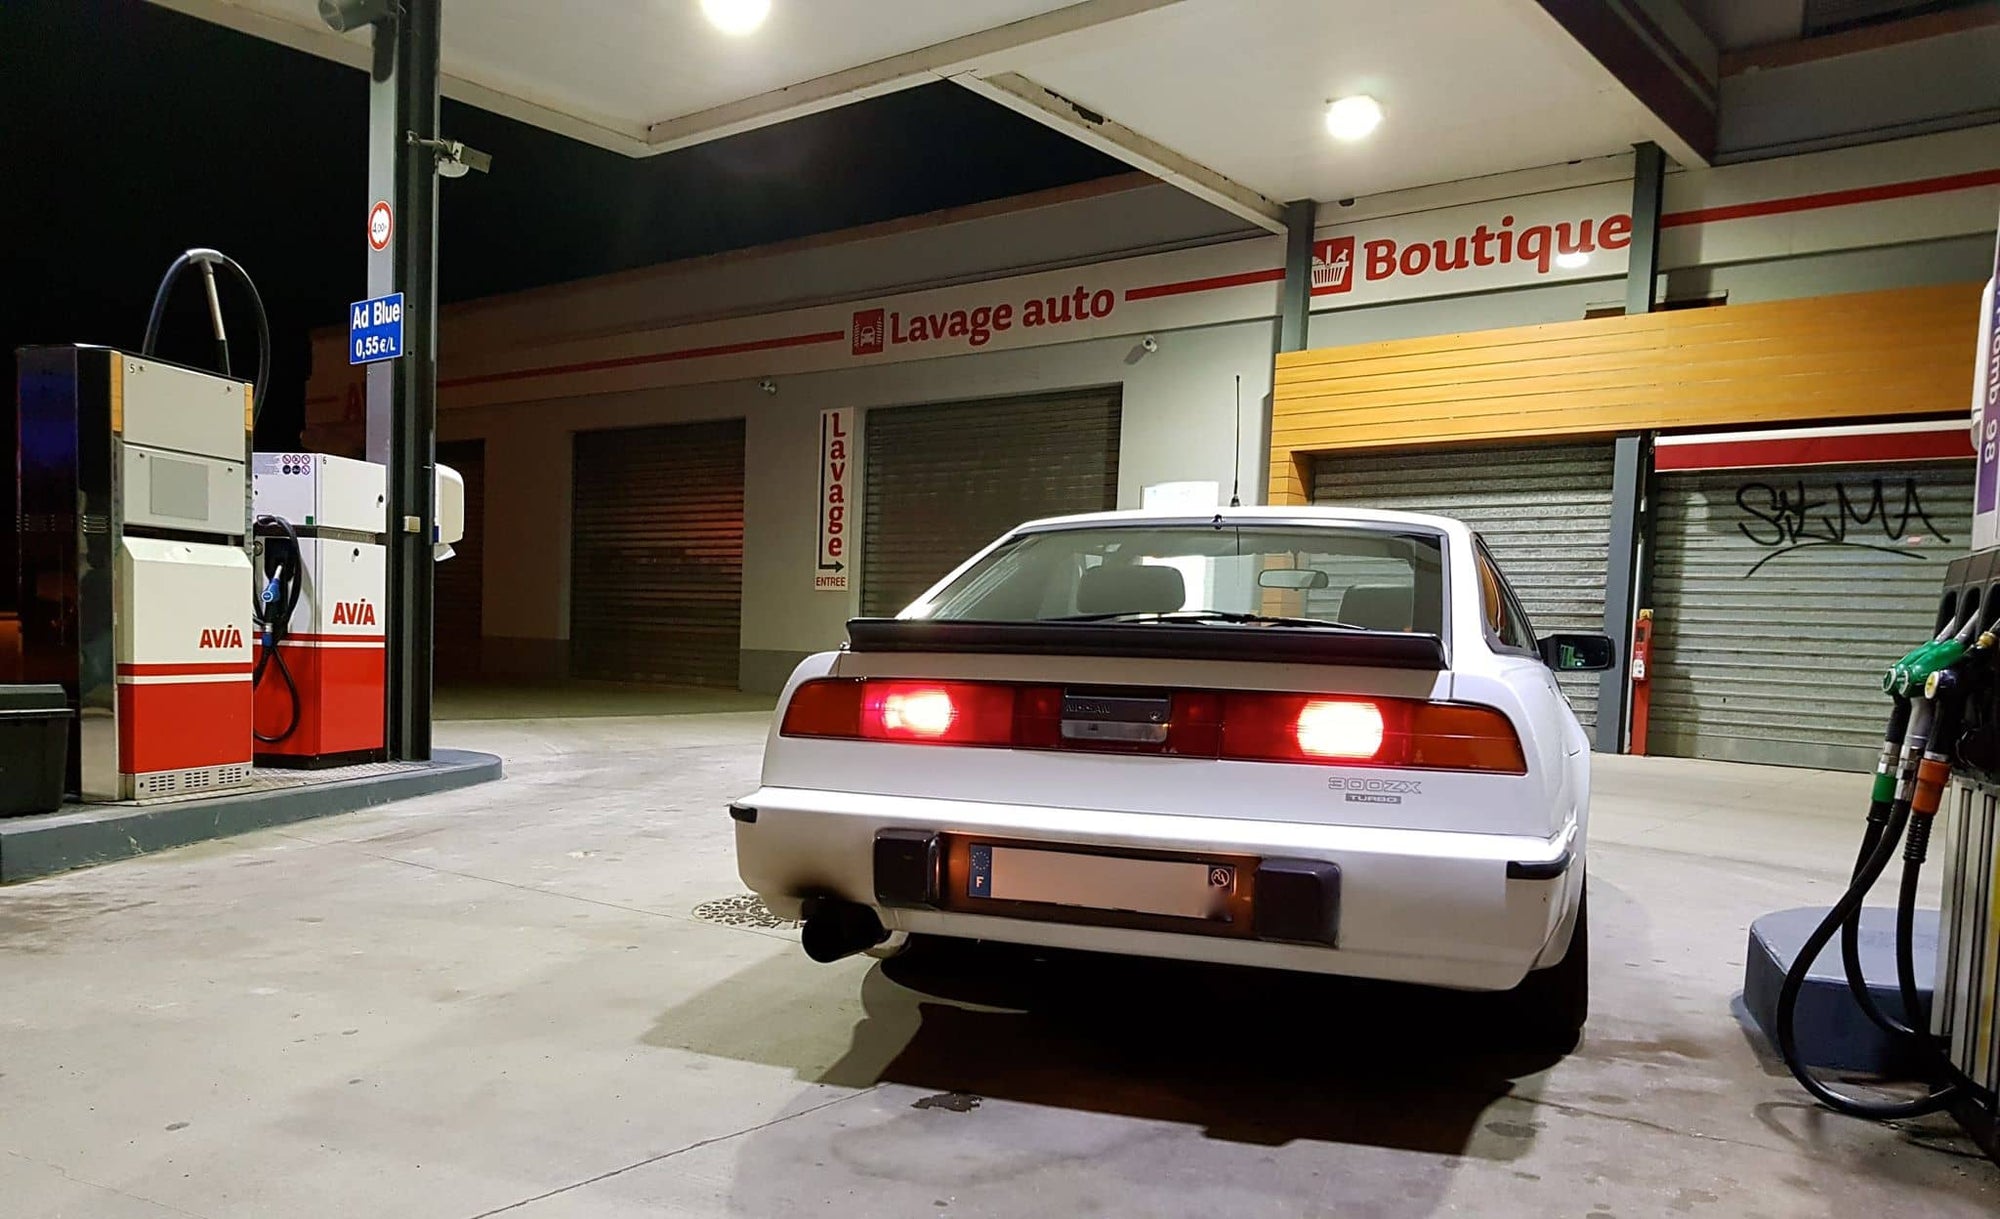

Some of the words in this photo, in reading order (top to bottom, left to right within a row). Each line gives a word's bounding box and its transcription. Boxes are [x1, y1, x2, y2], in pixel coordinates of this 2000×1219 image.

[1363, 214, 1633, 281] Boutique
[352, 304, 369, 330] Ad
[373, 300, 401, 326] Blue
[890, 302, 1013, 346] Lavage
[1022, 285, 1115, 327] auto
[1985, 419, 1998, 464] 98
[828, 412, 847, 557] Lavage
[816, 576, 846, 587] ENTREE
[332, 598, 376, 626] AVIA
[199, 624, 243, 648] AVIA
[1328, 777, 1422, 794] 300ZX
[976, 876, 984, 888] F
